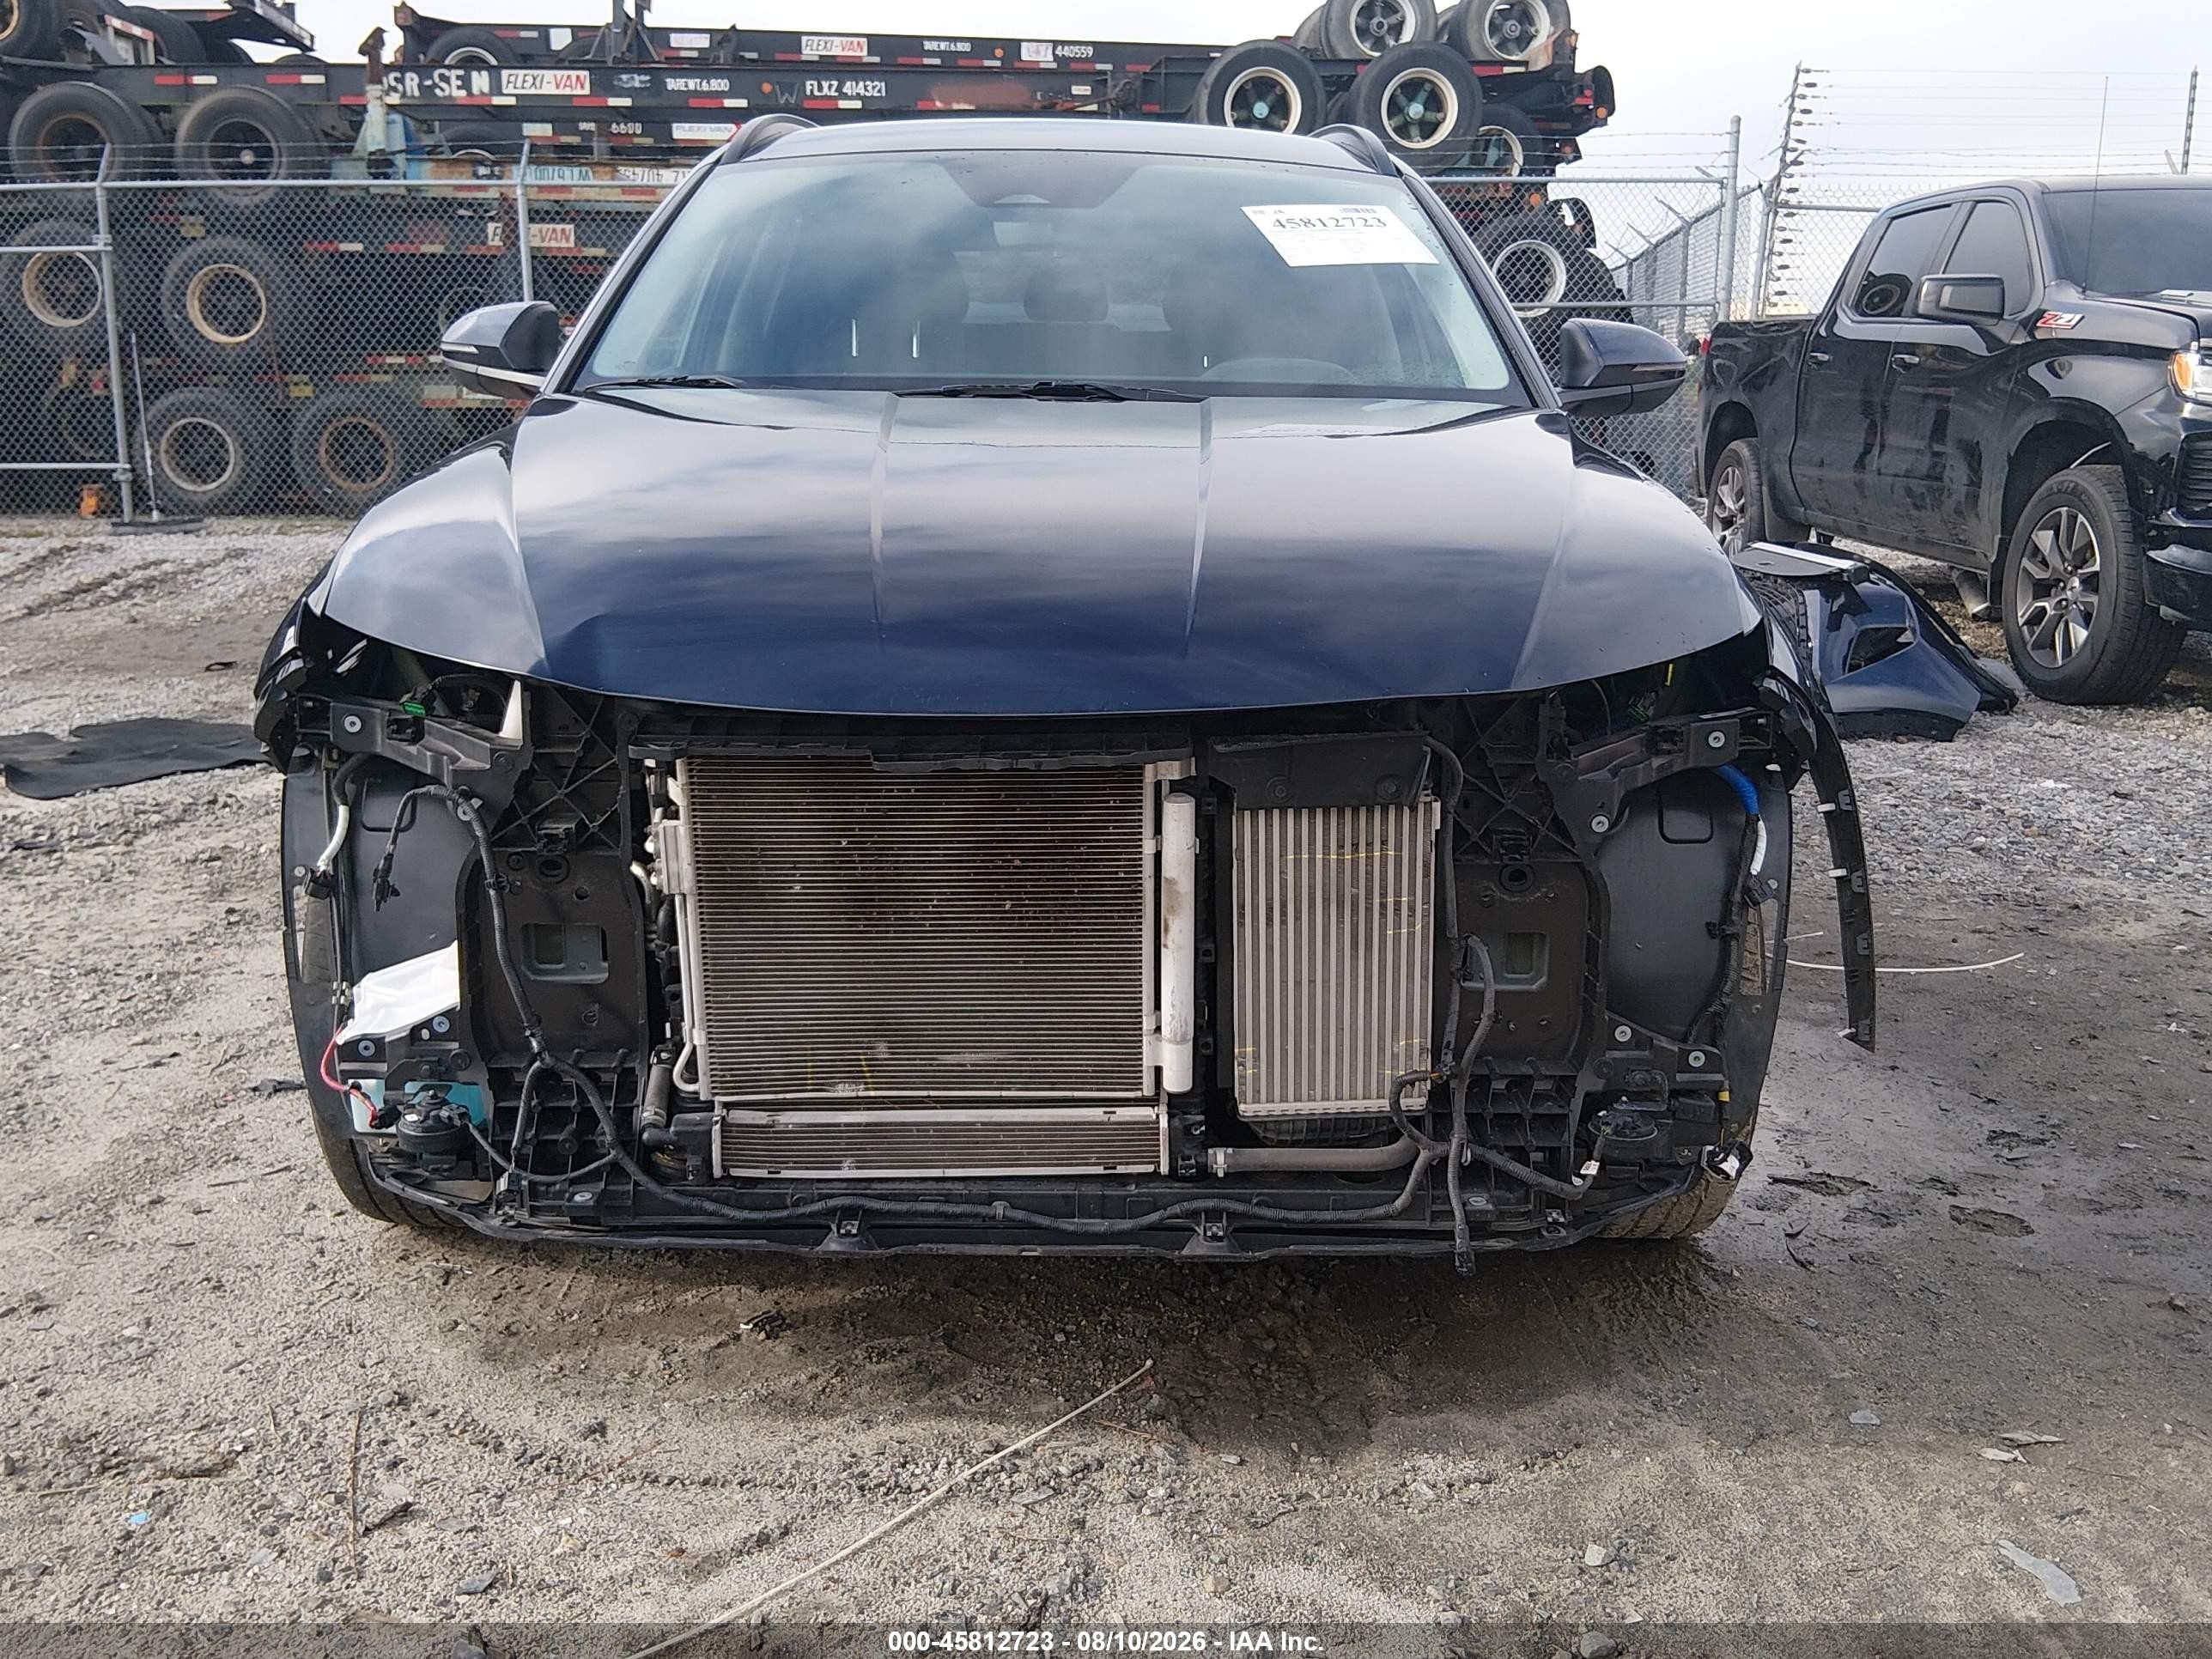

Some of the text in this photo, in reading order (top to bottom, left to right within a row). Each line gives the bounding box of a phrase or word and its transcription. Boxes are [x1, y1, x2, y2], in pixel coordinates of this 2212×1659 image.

[805, 37, 864, 53] FLEXI-VAN
[1054, 46, 1094, 58] 440559
[505, 73, 587, 90] FLEXI-VAN
[805, 81, 885, 97] FLXZ 414321
[1273, 216, 1387, 229] 45812723
